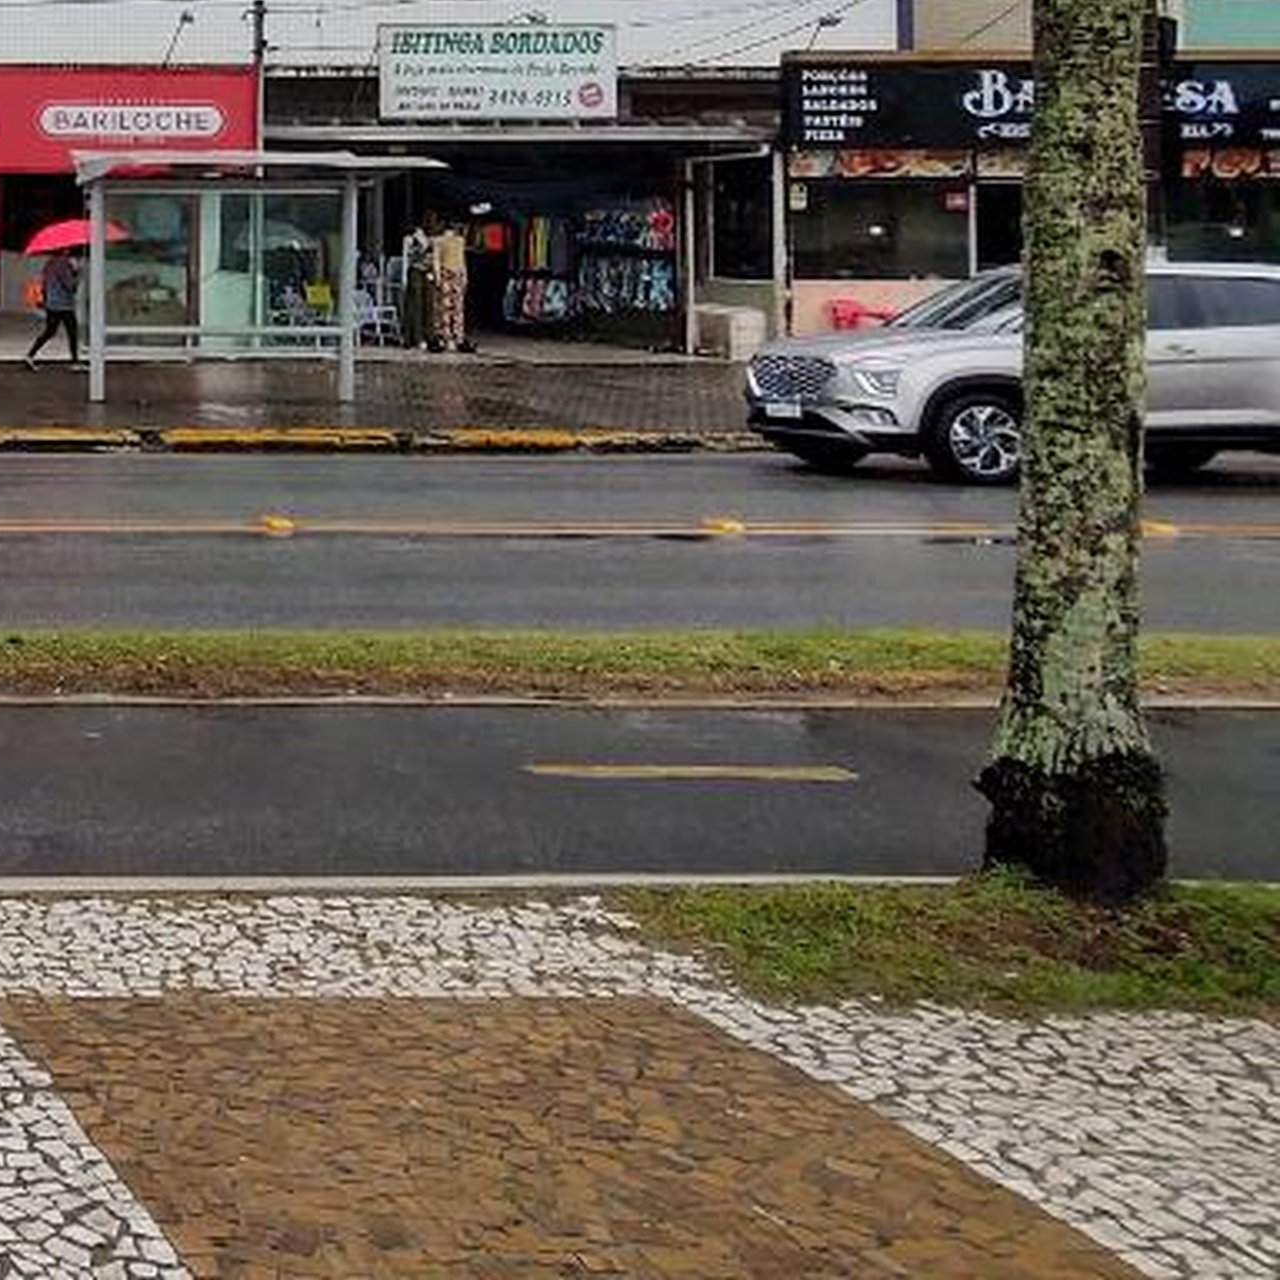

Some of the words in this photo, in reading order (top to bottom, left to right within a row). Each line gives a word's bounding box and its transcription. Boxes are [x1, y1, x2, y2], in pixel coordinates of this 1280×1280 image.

[390, 32, 485, 55] IBITINGA
[490, 32, 605, 55] BORDADOS
[54, 110, 211, 131] BARILOCHE
